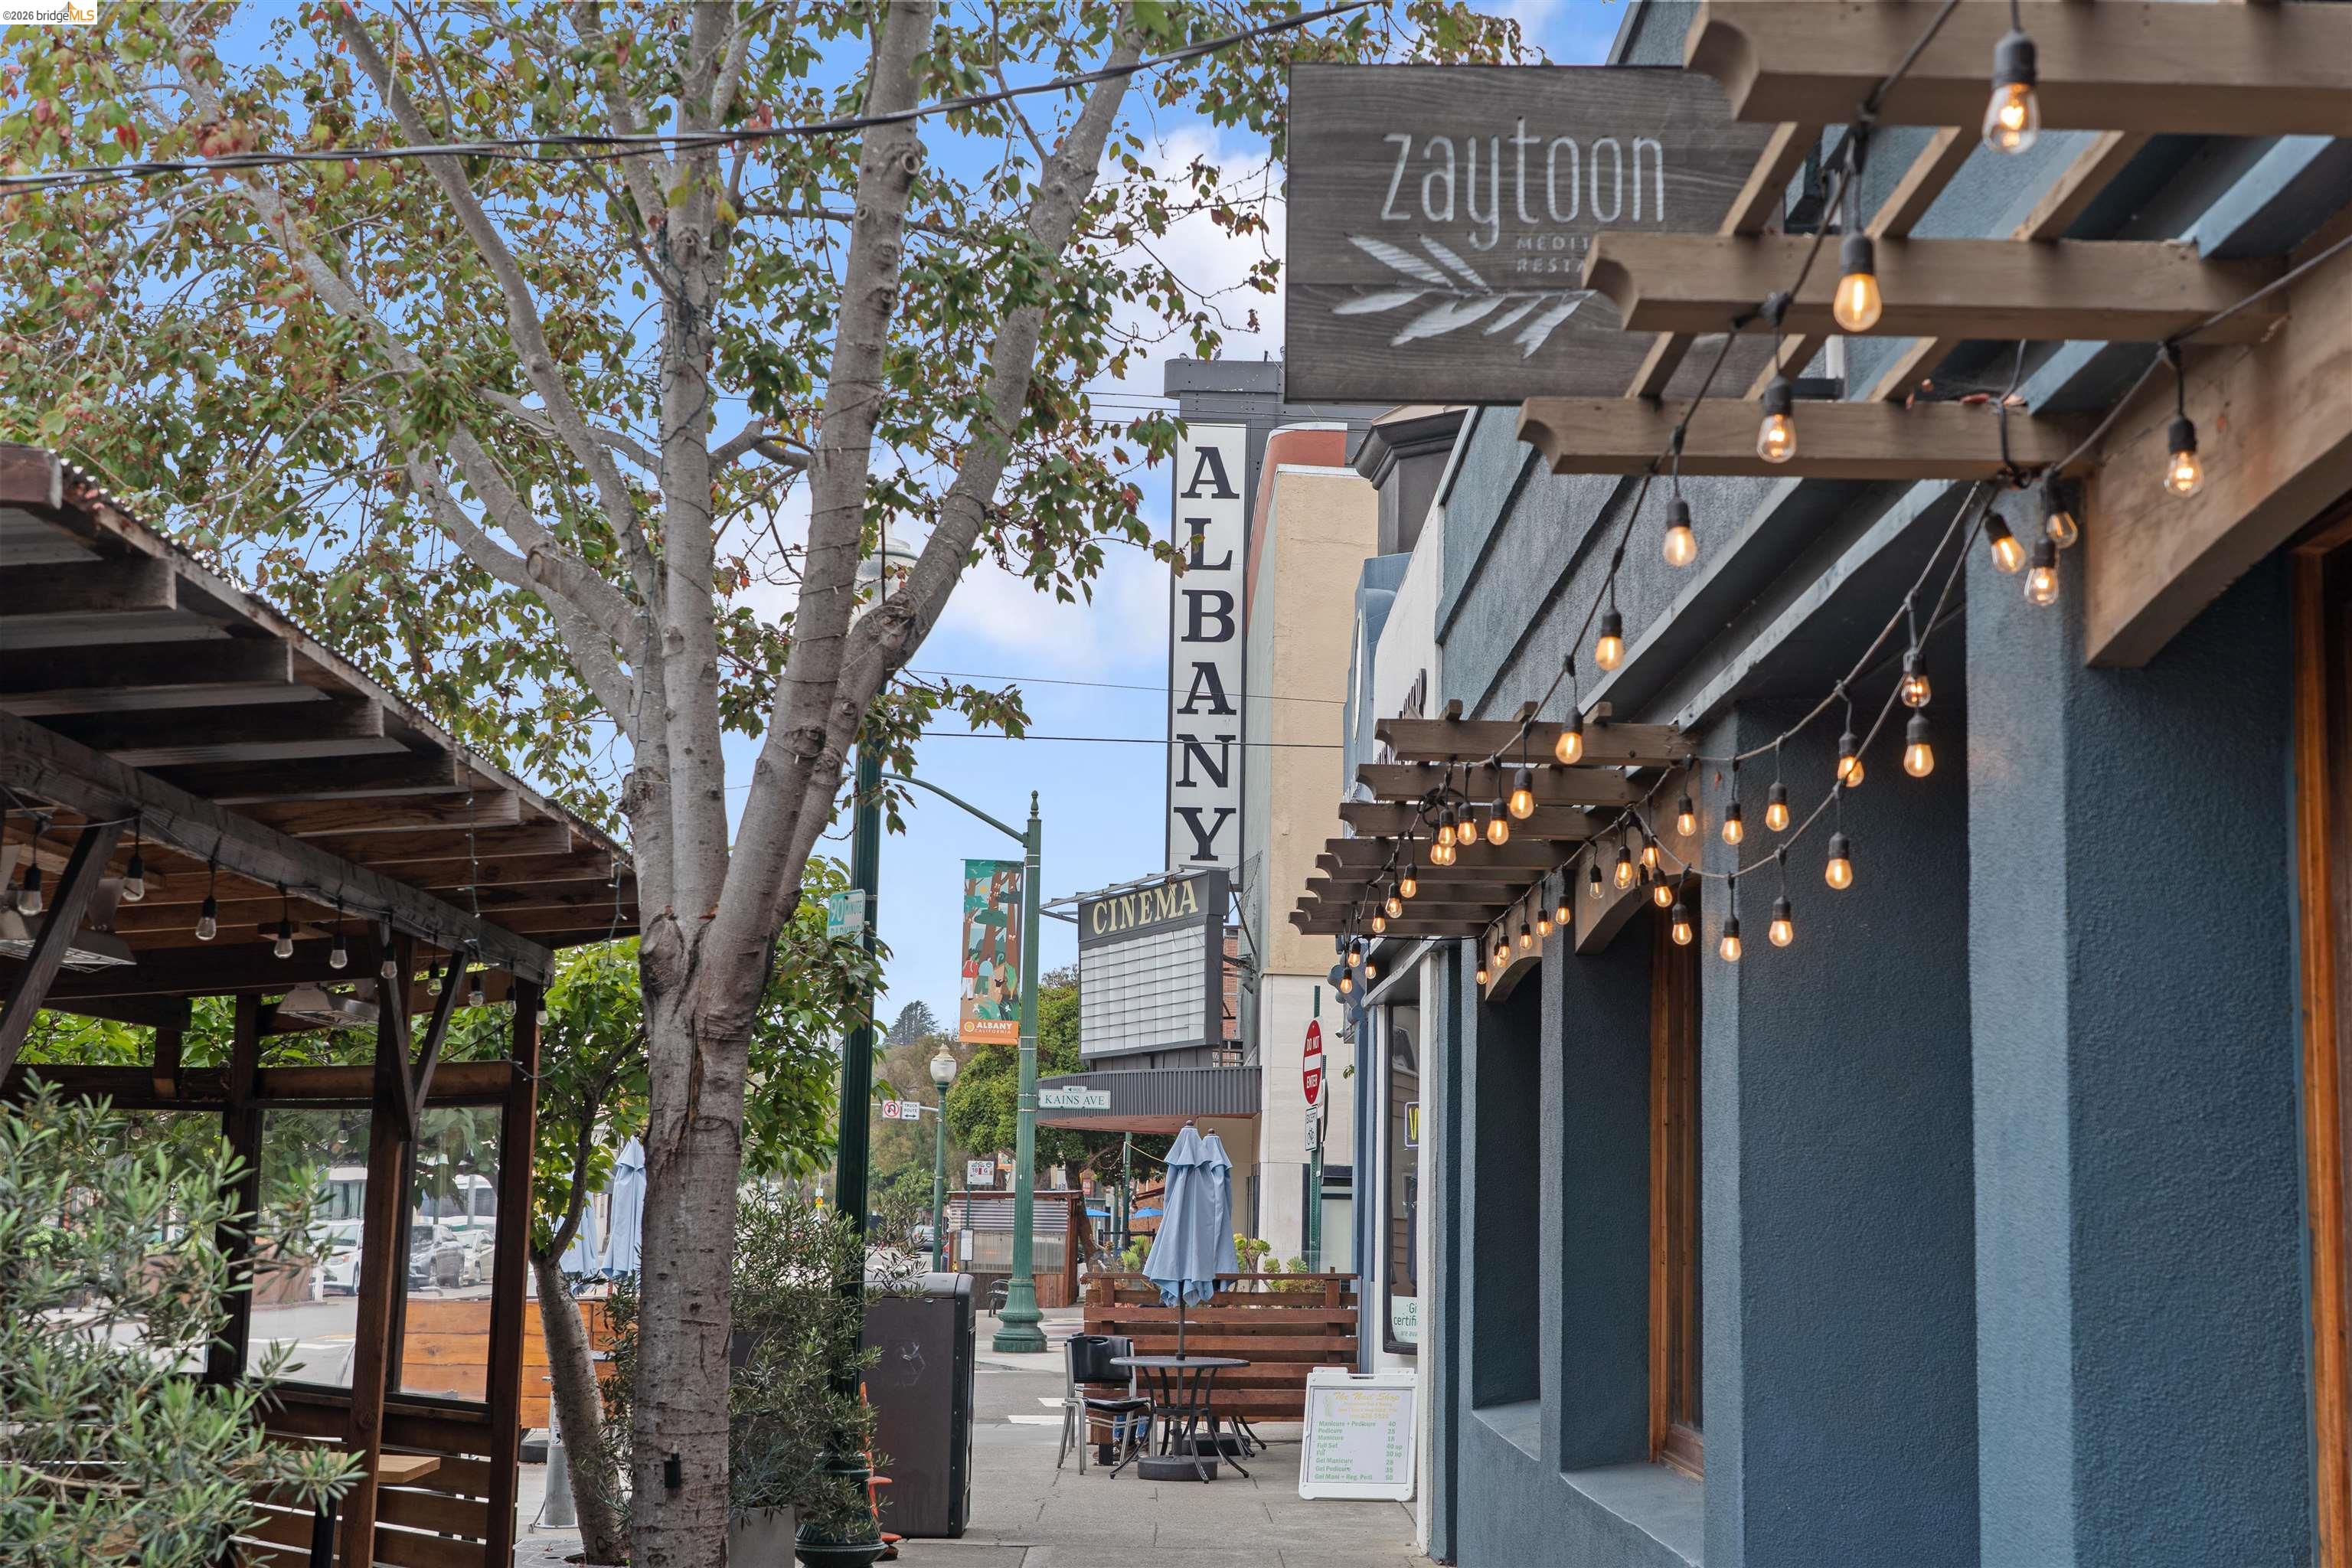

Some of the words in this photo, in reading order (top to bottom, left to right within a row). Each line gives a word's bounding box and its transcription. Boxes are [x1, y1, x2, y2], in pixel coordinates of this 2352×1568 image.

[1380, 116, 1664, 251] zaytoon
[1174, 446, 1240, 861] ALBANY
[831, 898, 844, 923] 90
[1093, 879, 1199, 935] CINEMA
[976, 1021, 1012, 1030] ALBANY
[1306, 1038, 1312, 1051] DO
[1306, 1074, 1318, 1088] ENTER
[1045, 1095, 1080, 1105] KAINS
[1083, 1096, 1105, 1106] AVE
